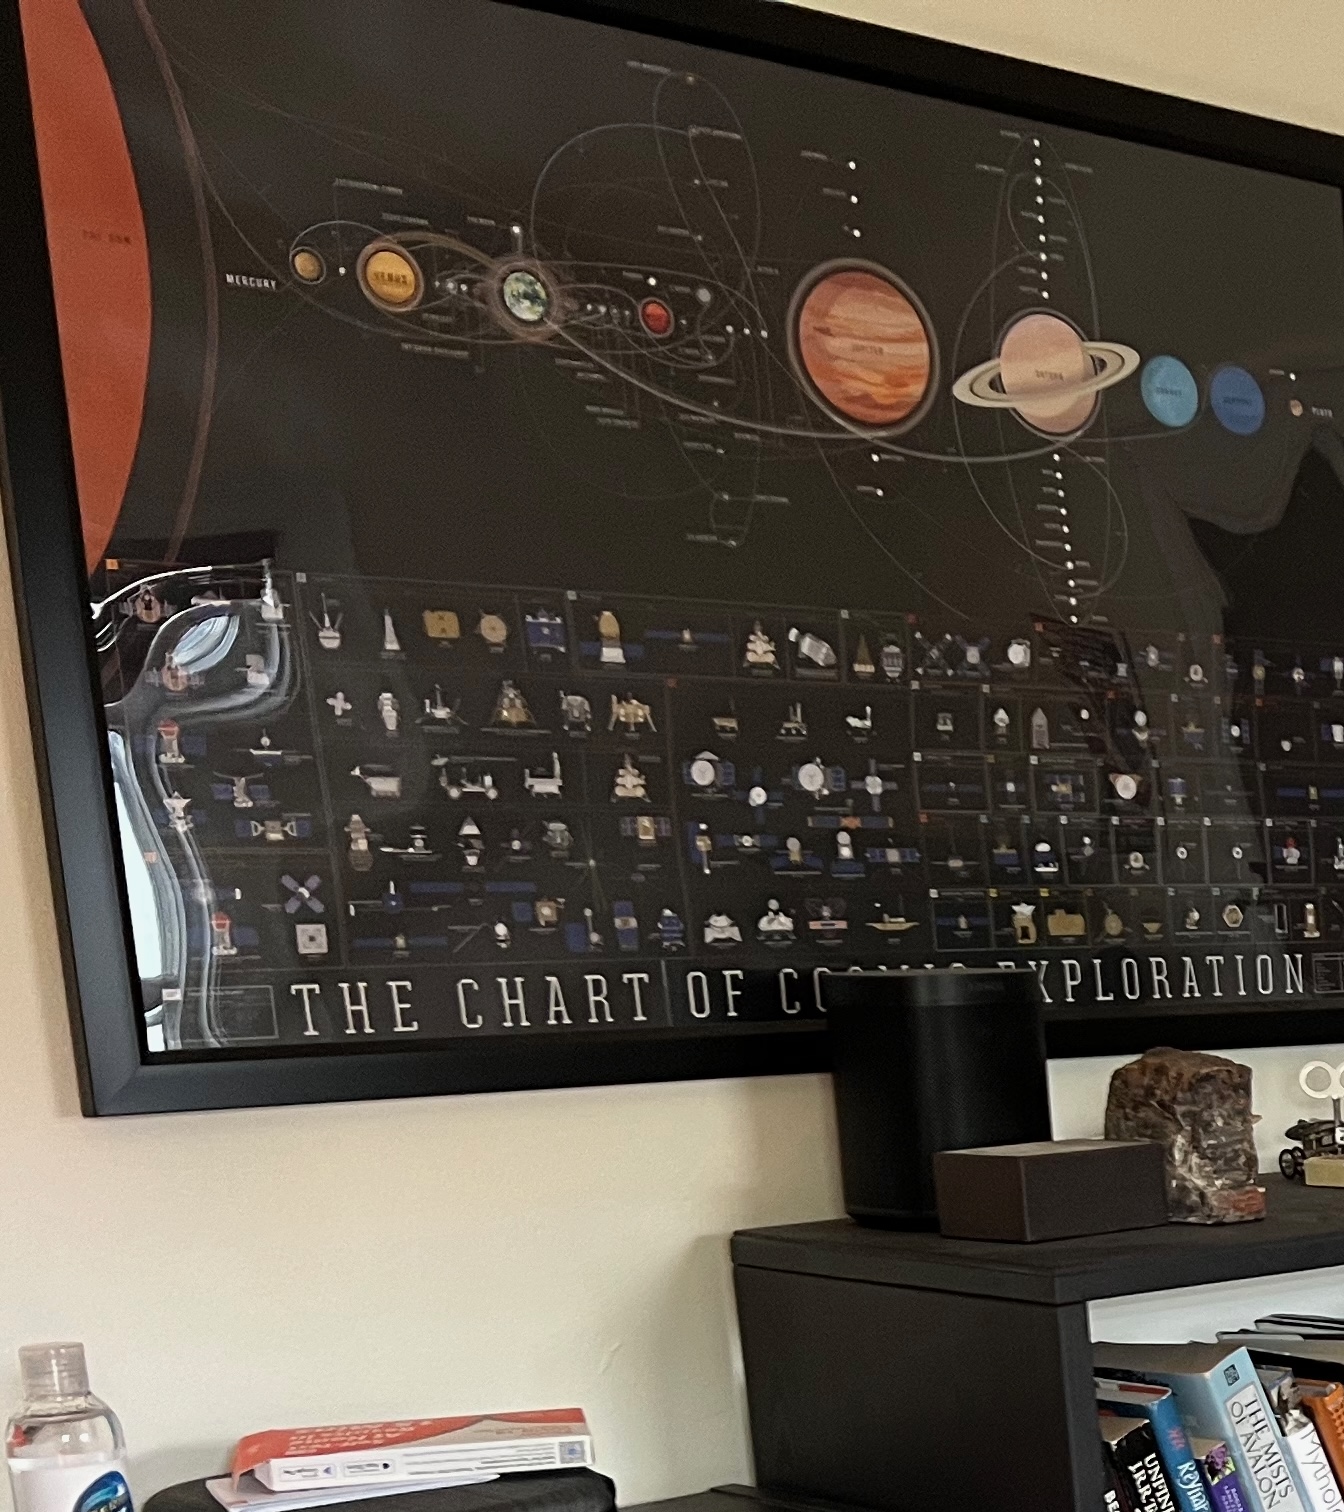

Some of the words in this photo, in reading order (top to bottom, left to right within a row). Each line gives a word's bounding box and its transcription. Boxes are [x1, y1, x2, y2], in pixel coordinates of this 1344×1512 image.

[226, 274, 277, 290] MERCURY
[290, 981, 420, 1035] THE
[457, 973, 649, 1030] CHART
[686, 970, 744, 1019] OF
[999, 953, 1304, 1005] XPLORATION
[1230, 1401, 1246, 1424] OF
[1239, 1432, 1280, 1509] AVALON
[1244, 1399, 1268, 1433] THE
[1264, 1442, 1290, 1497] MISTS
